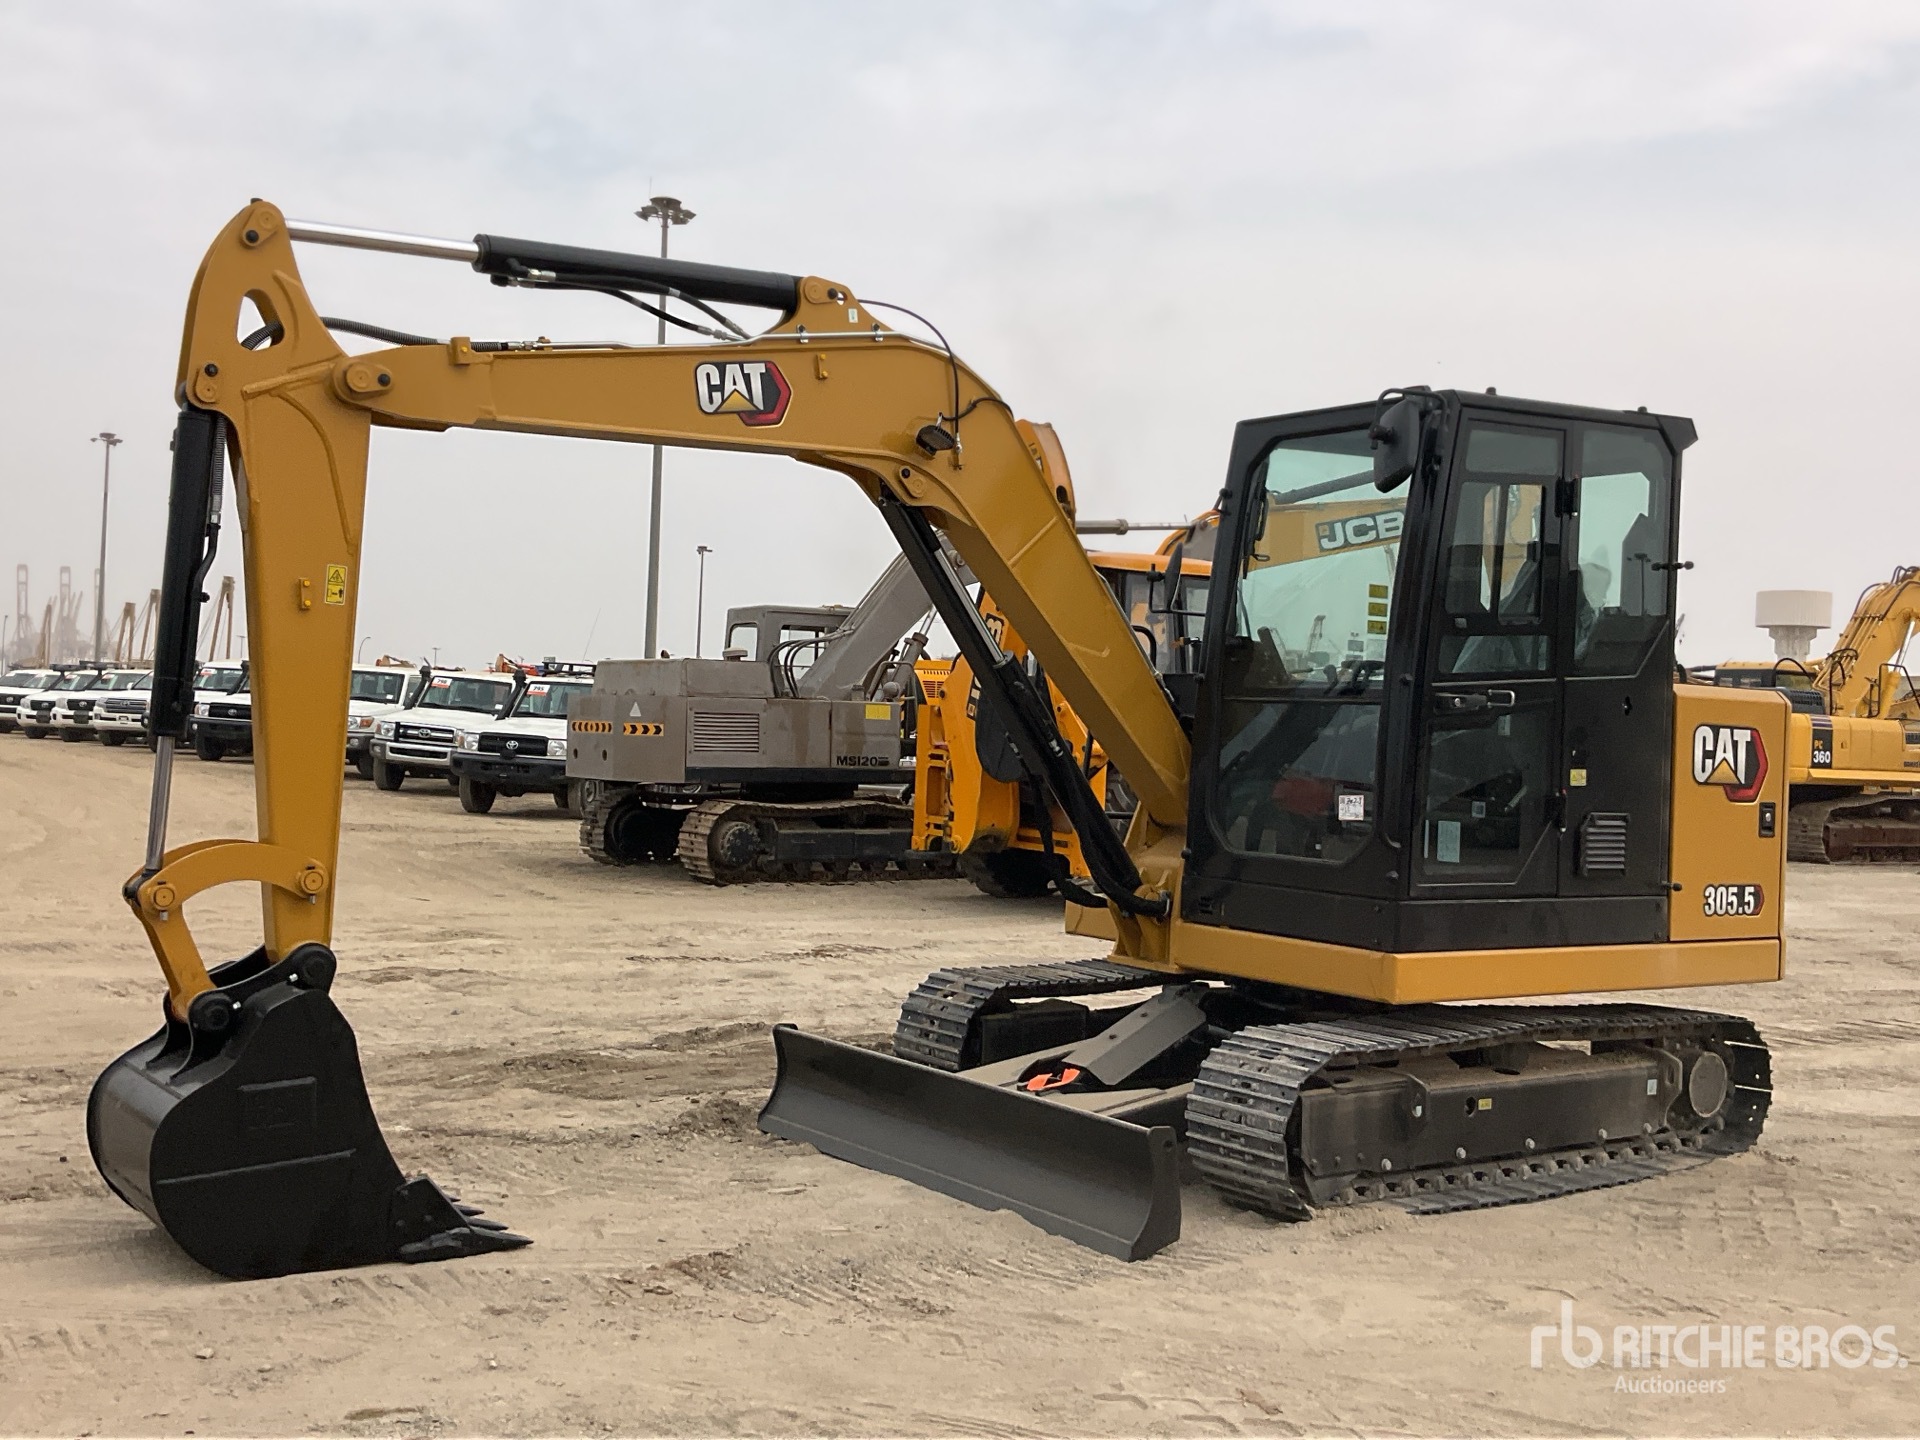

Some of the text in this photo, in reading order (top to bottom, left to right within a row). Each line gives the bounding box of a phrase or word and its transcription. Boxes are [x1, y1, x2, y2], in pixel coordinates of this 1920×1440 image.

[696, 362, 766, 413] CAT
[1320, 511, 1405, 550] JCB
[1694, 725, 1751, 784] CAT
[1812, 750, 1831, 764] 360
[1704, 886, 1755, 916] 305.5
